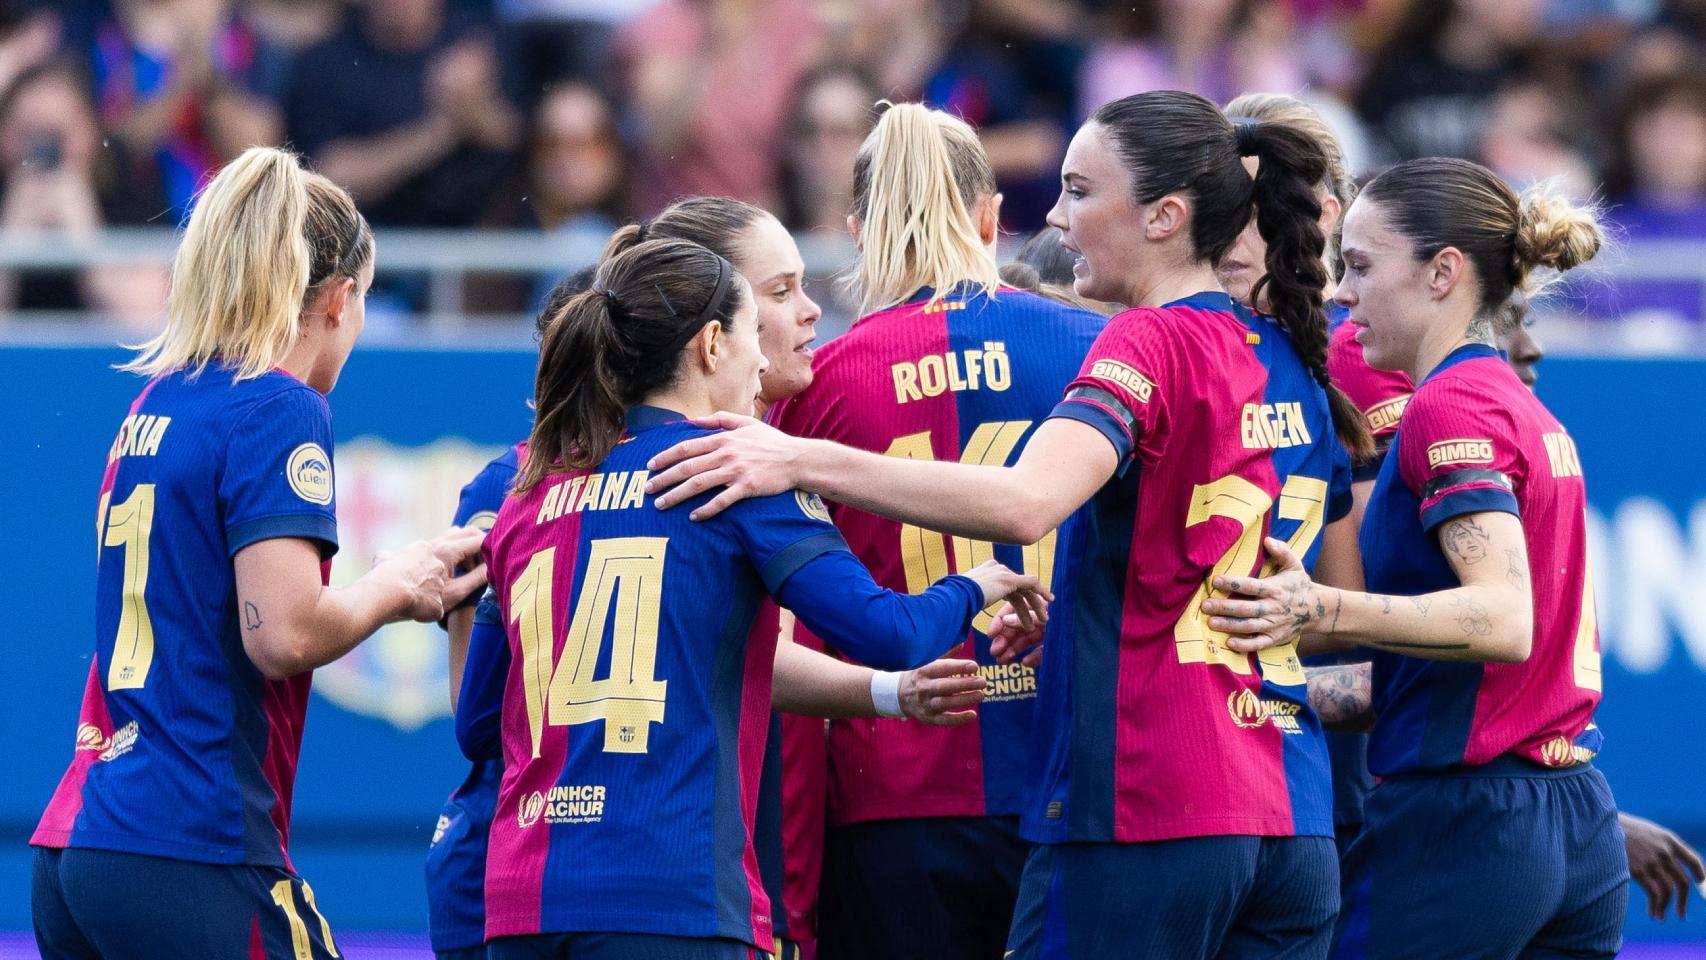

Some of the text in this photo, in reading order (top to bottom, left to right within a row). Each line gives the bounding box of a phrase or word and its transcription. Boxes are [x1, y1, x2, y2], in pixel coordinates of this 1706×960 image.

[891, 341, 1011, 404] ROLFÖ
[1091, 361, 1153, 402] BIMBO
[1241, 402, 1313, 449] ENGEN
[1366, 399, 1409, 429] BIM
[1428, 442, 1493, 466] BIMBO
[536, 470, 650, 525] AITANA
[511, 536, 670, 759] 14
[977, 663, 1035, 680] NHCR
[982, 676, 1036, 695] CNUR
[1261, 700, 1301, 715] NHCR
[547, 786, 606, 802] UNHCR
[543, 801, 604, 817] ACNUR
